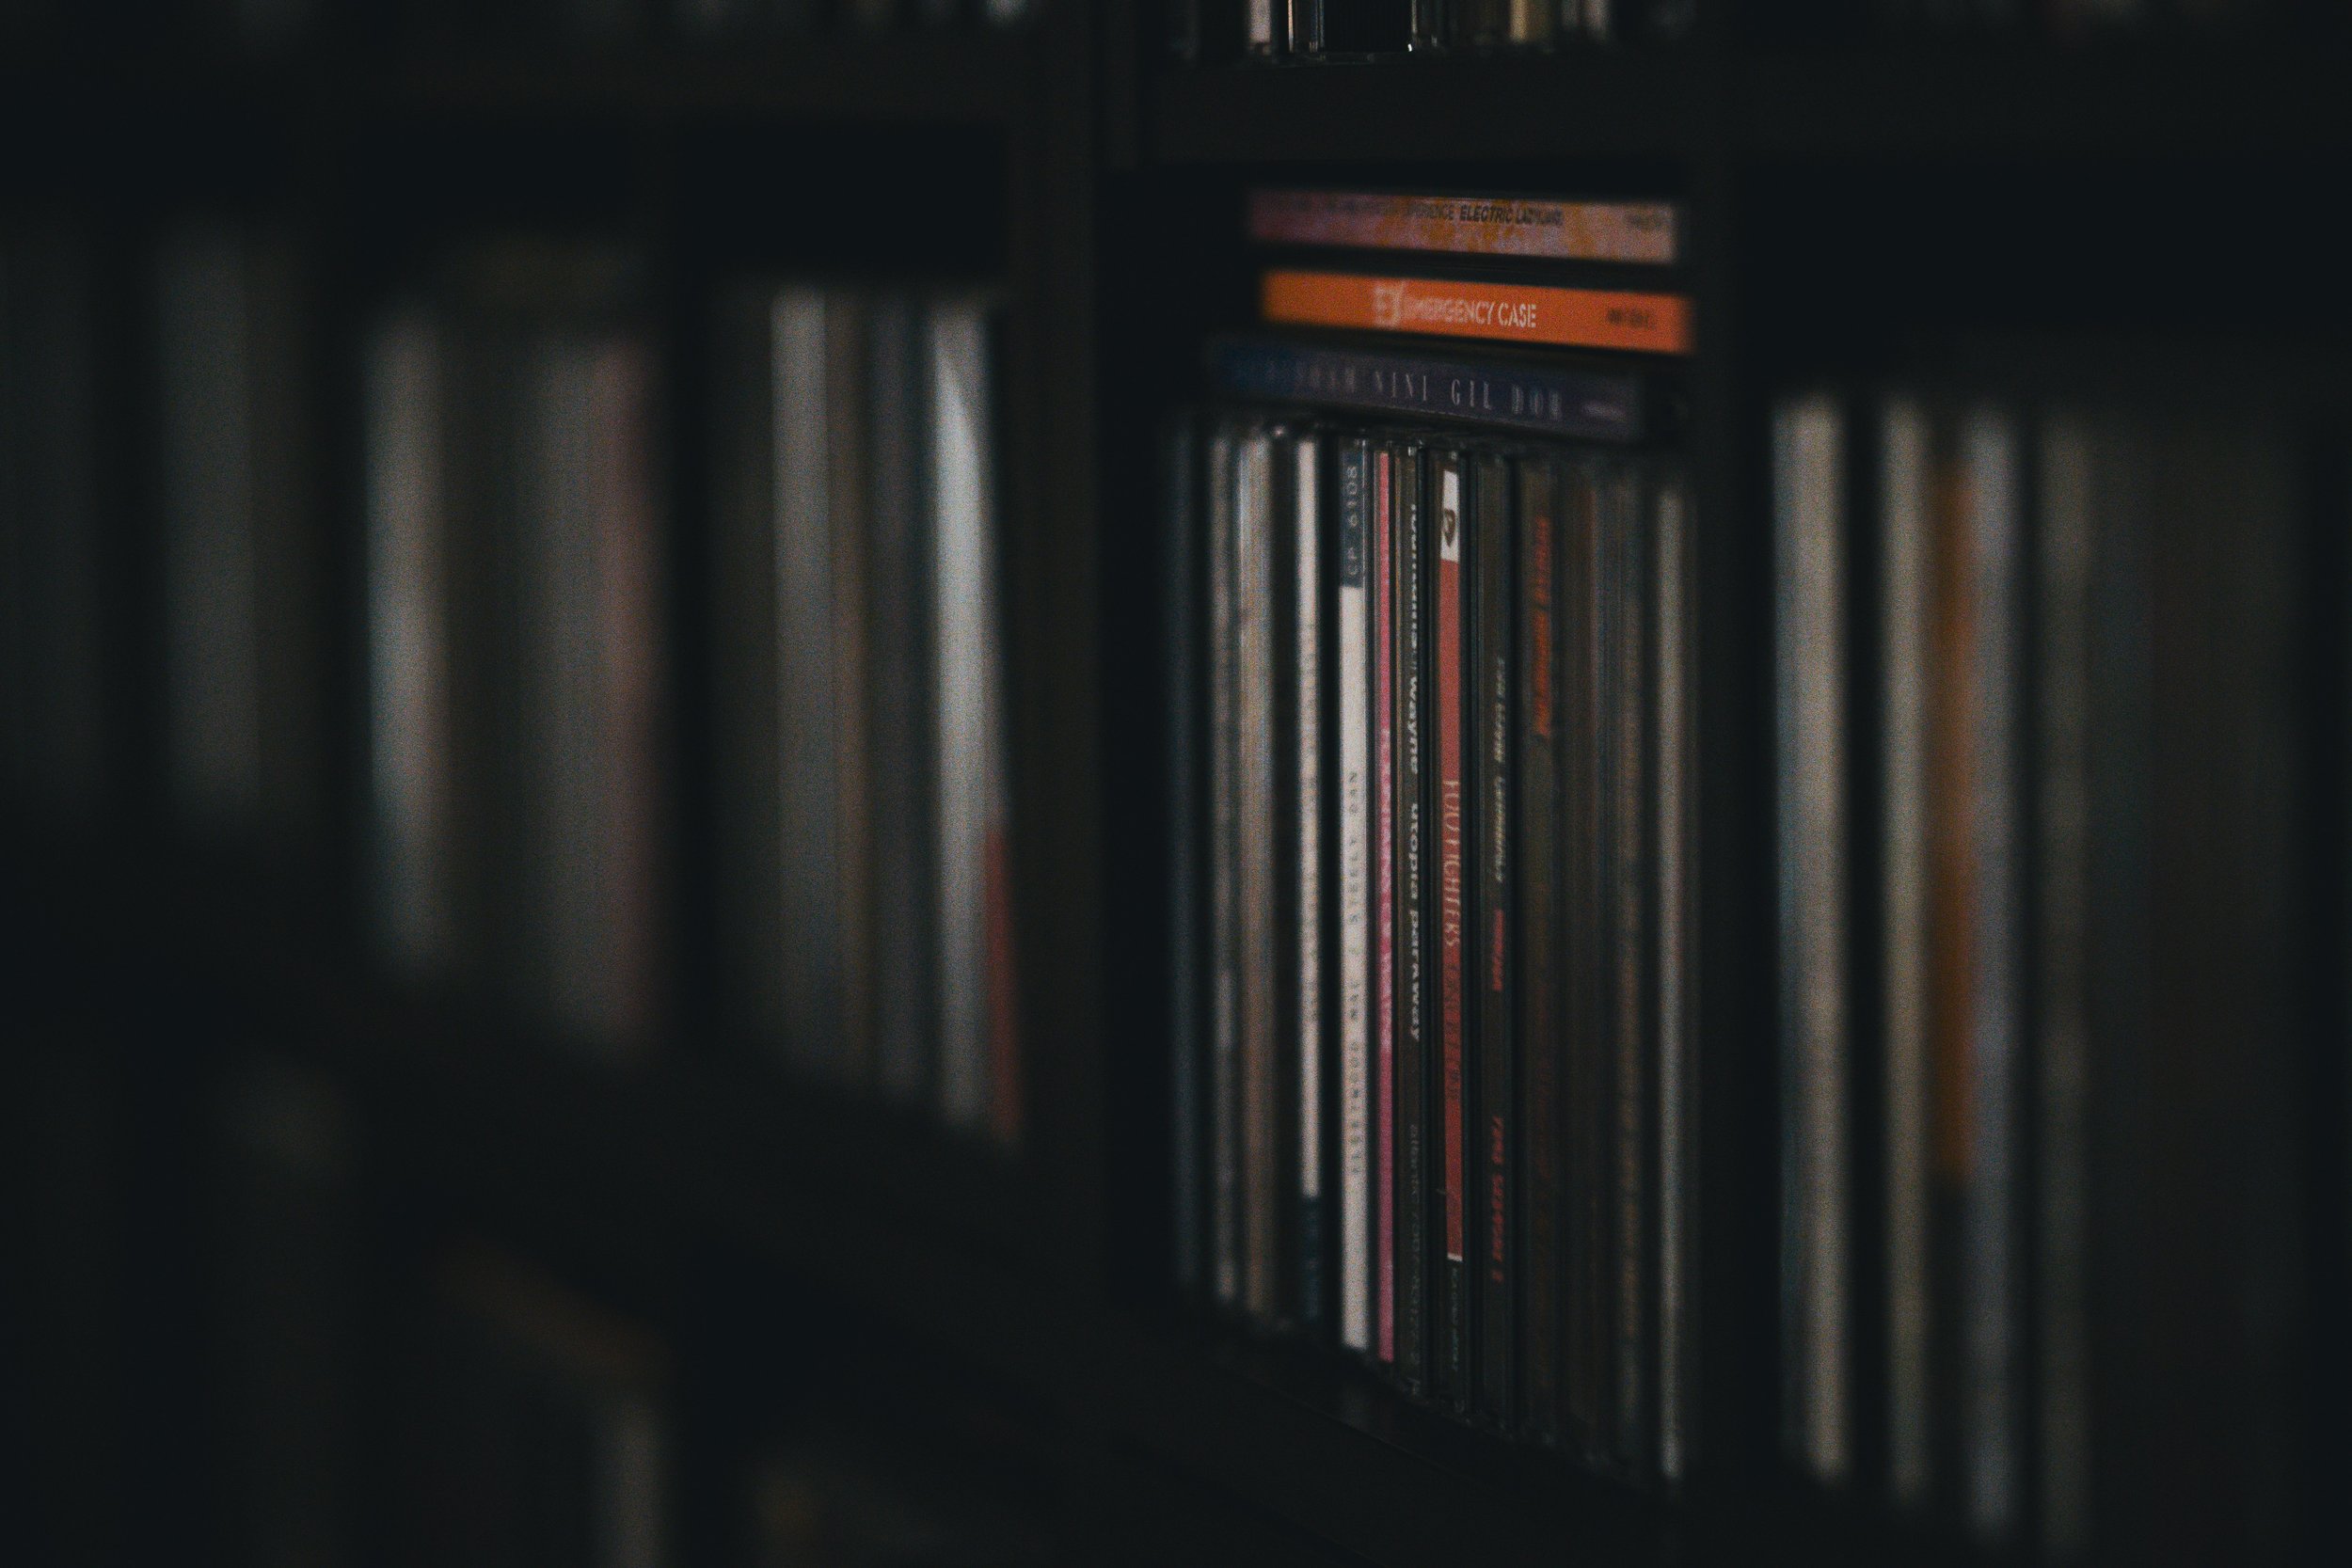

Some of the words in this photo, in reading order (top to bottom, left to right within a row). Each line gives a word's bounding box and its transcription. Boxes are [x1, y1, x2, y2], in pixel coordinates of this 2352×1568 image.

[1459, 204, 1514, 224] ELECTRIC
[1498, 301, 1537, 328] CASE
[1450, 378, 1492, 410] GIL
[1346, 465, 1358, 526] 6108
[1348, 546, 1358, 576] CP
[1406, 676, 1418, 774] wayne
[1348, 770, 1359, 813] DAN
[1443, 780, 1460, 830] FOO
[1408, 803, 1419, 899] utopia
[1443, 838, 1460, 946] FIGHTERS
[1407, 909, 1420, 1040] parkway
